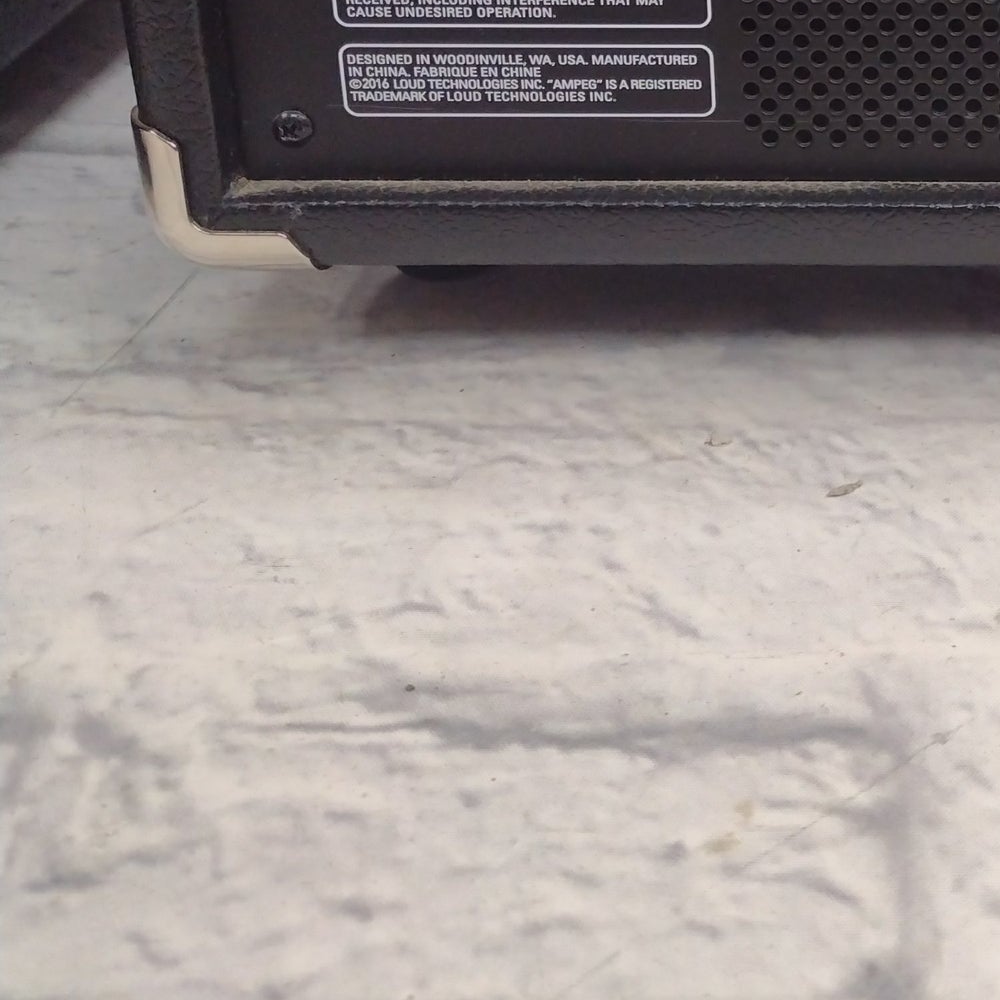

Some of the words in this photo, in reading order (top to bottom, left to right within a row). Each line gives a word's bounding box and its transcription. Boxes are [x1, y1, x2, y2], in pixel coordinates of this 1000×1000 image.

[347, 7, 392, 18] CAUSE
[395, 7, 472, 18] UNDESIRED
[477, 7, 556, 18] OPERATION.
[347, 54, 412, 65] DESIGNED
[416, 54, 430, 65] IN
[433, 54, 527, 67] WOODINVILLE,
[529, 54, 555, 67] WA,
[558, 55, 588, 65] USA.
[592, 55, 697, 65] MANUFACTURED
[349, 67, 362, 77] IN
[365, 67, 411, 77] CHINA.
[413, 67, 478, 77] FABRIQUE
[481, 67, 498, 77] EN
[501, 67, 541, 77] CHINE
[393, 79, 425, 89] LOUD
[428, 79, 518, 89] TECHNOLOGIES
[521, 79, 545, 90] INC.
[605, 79, 617, 90] IS
[619, 79, 629, 90] A
[631, 79, 702, 90] REGISTERED
[350, 91, 427, 101] TRADEMARK
[429, 91, 444, 102] OF
[447, 91, 481, 102] LOUD
[485, 91, 585, 102] TECHNOLOGIES
[590, 92, 617, 102] INC.
